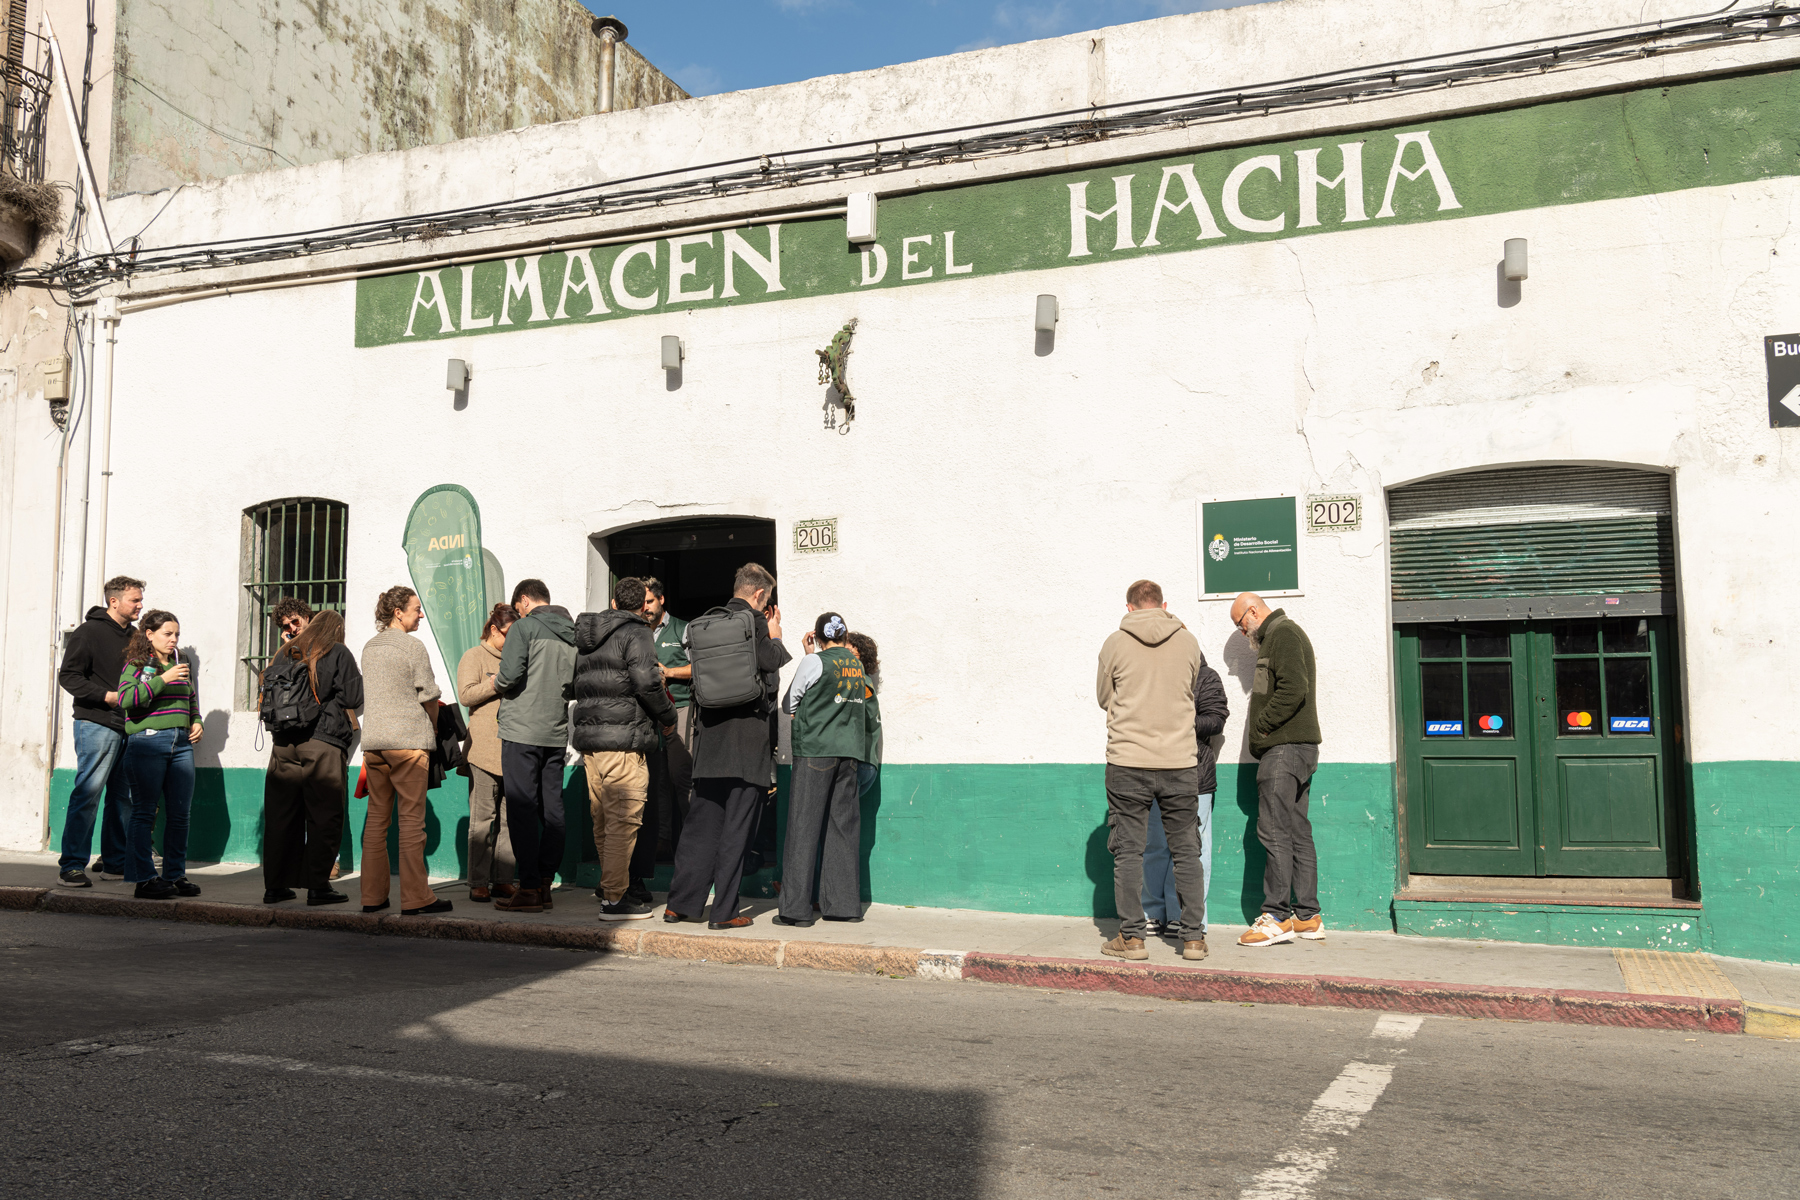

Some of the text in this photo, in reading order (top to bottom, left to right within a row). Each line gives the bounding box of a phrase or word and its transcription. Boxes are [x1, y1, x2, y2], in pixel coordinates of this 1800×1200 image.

[403, 130, 1463, 338] ALMACEN DEL HACHA
[1773, 341, 1800, 357] Bu
[1313, 501, 1355, 524] 202
[798, 526, 831, 548] 206
[841, 667, 863, 678] INDA
[1428, 724, 1462, 732] OCA
[1612, 720, 1649, 728] OCA
